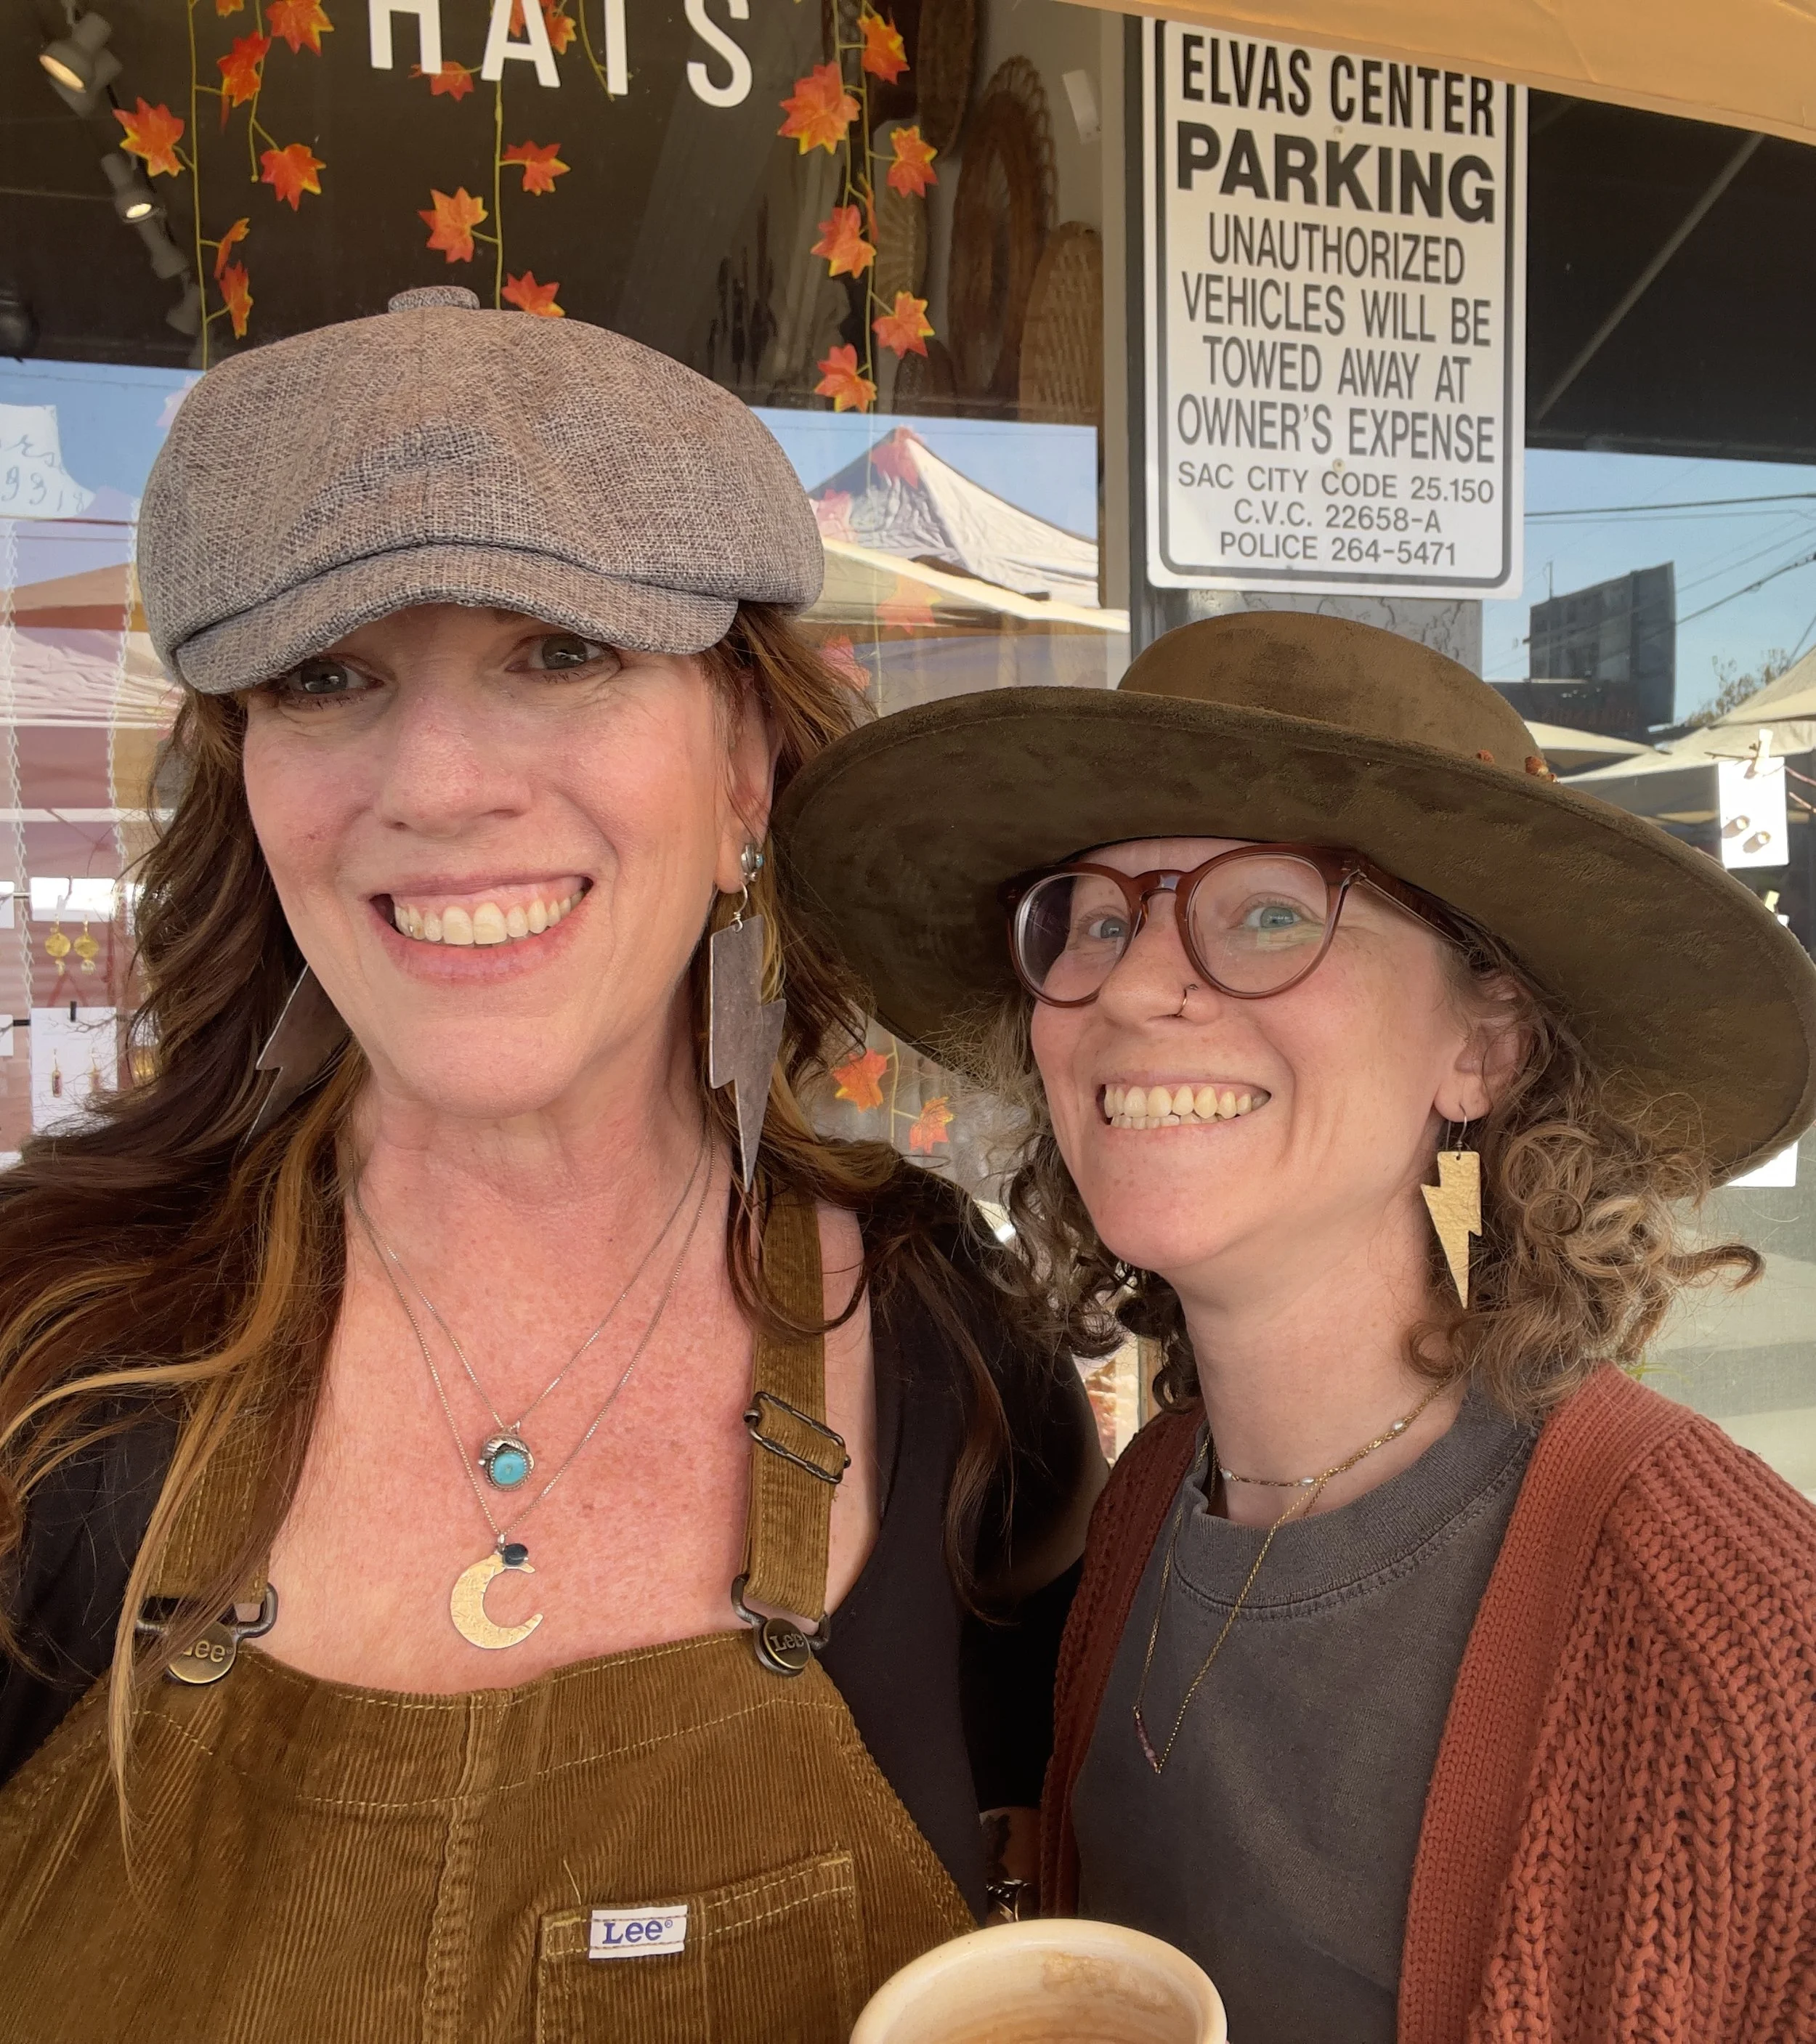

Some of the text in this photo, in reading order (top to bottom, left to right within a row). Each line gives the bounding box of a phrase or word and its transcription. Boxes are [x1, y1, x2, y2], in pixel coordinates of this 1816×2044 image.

[1183, 33, 1496, 137] ELVAS CENTER
[1177, 120, 1496, 224] PARKING
[1209, 211, 1465, 285] UNAUTHORIZED
[1181, 271, 1491, 347] VEHICLES WILL BE
[1202, 336, 1471, 404] TOWED AWAY AT
[1177, 394, 1494, 463] OWNER'S EXPENSE
[1177, 461, 1494, 503] SAC CITY CODE 25.150
[1234, 498, 1442, 533] C.V.C. 22658-A
[1220, 531, 1455, 567] POLICE 264-5471
[769, 1632, 805, 1652] Lee
